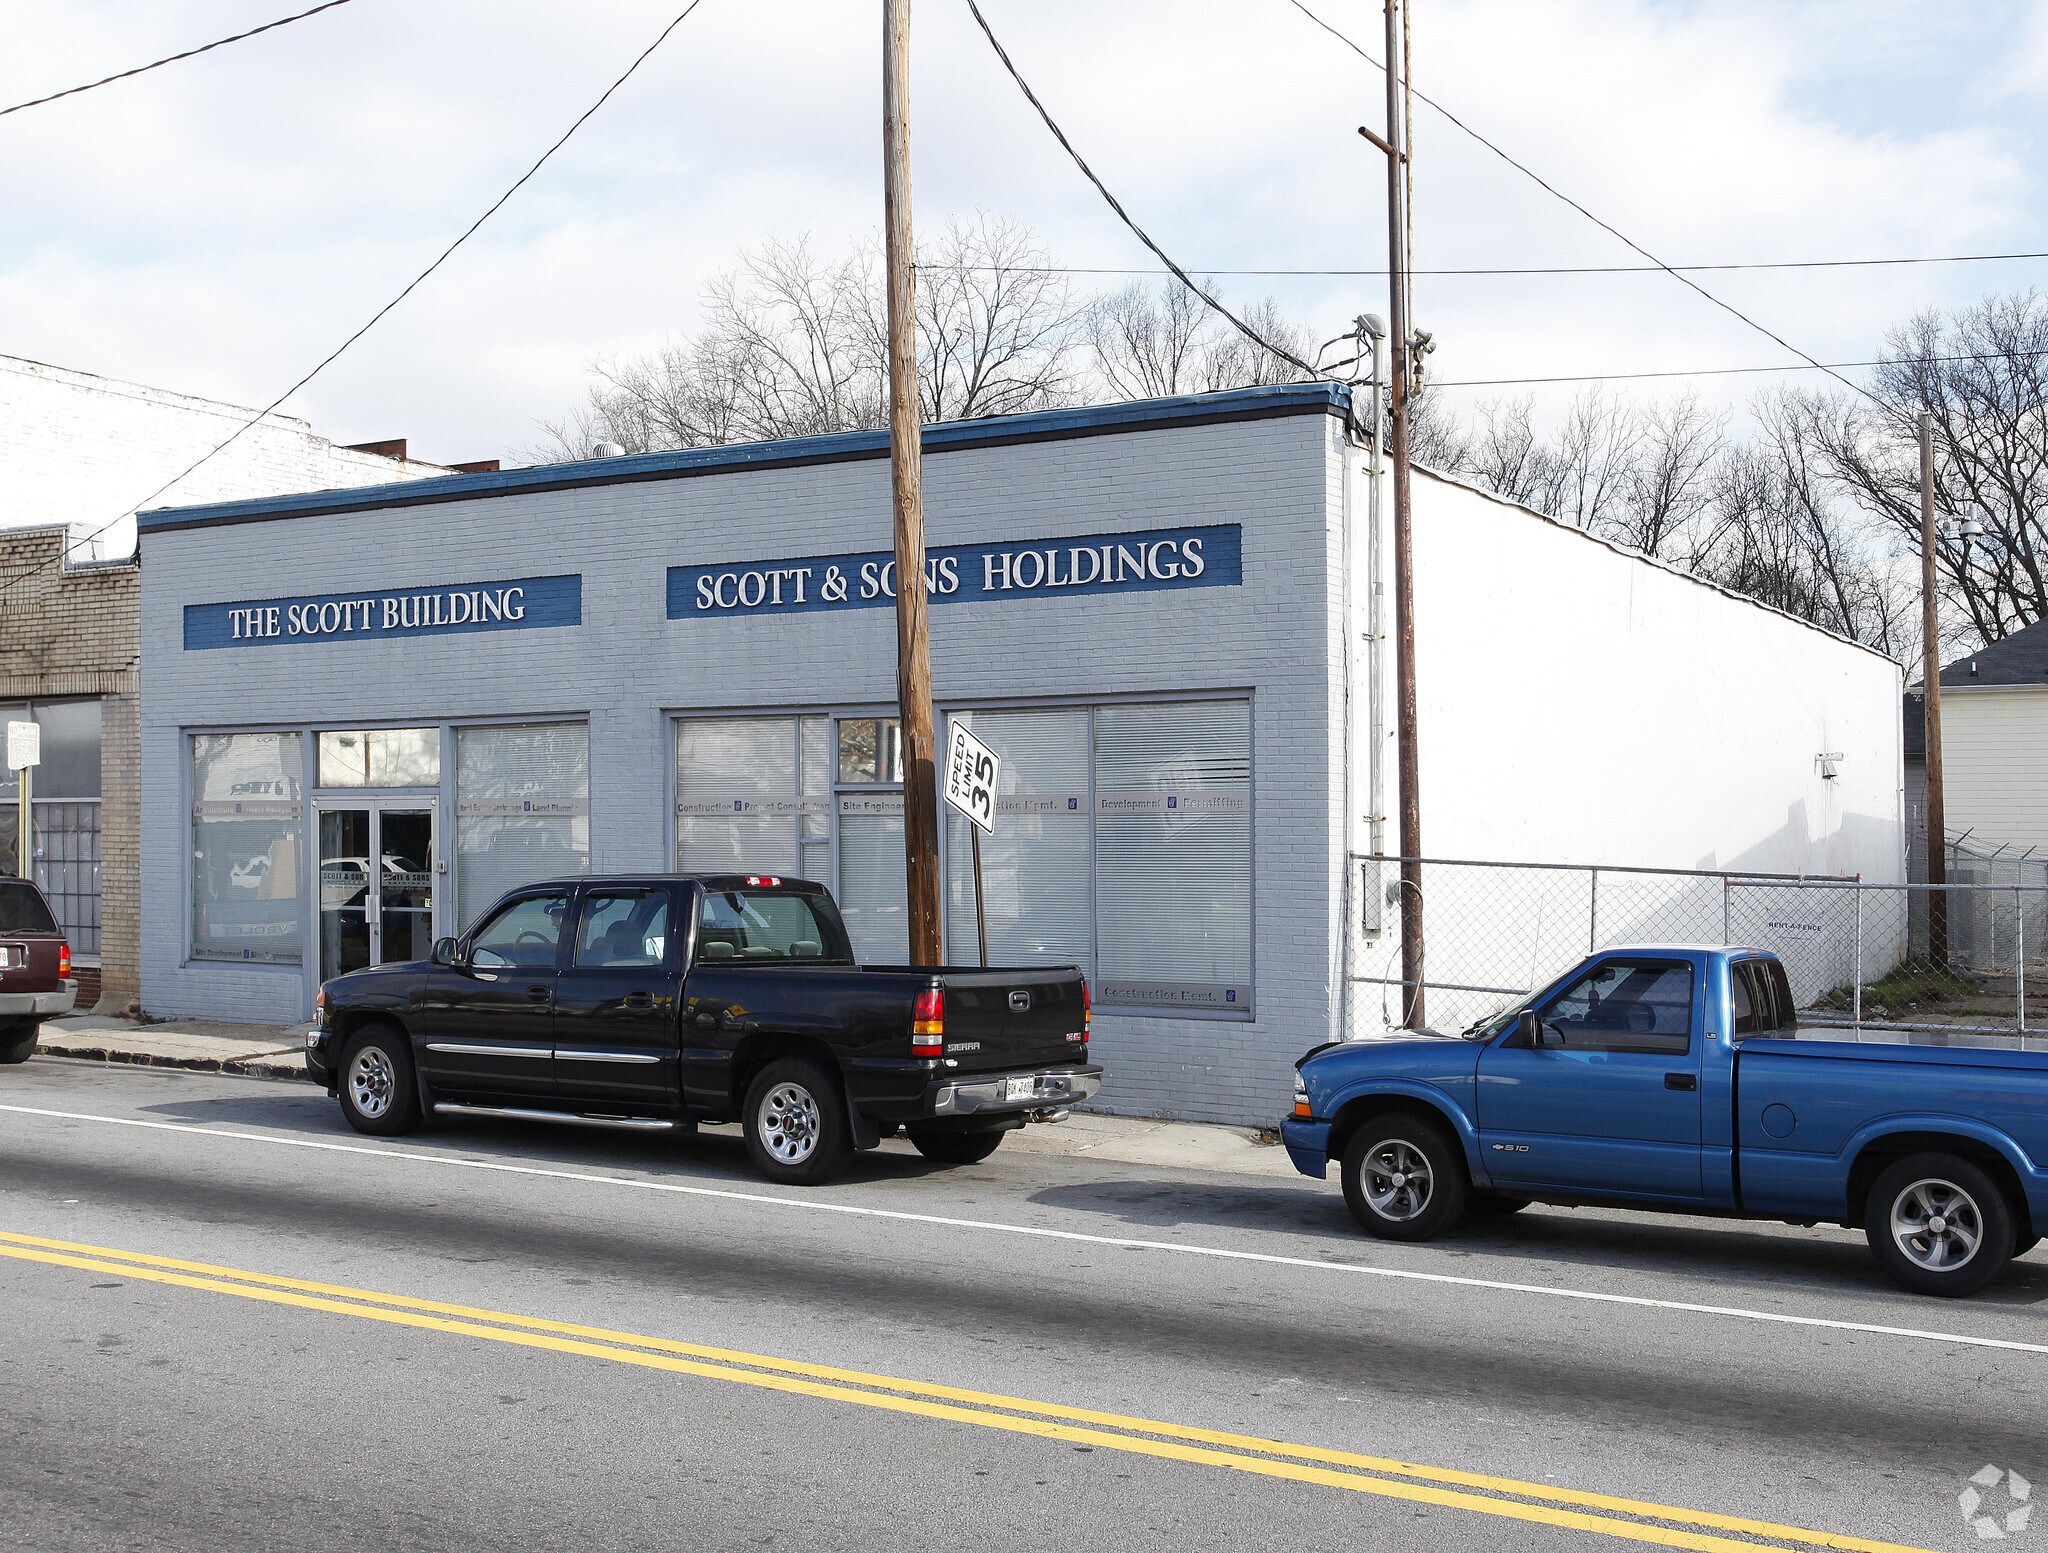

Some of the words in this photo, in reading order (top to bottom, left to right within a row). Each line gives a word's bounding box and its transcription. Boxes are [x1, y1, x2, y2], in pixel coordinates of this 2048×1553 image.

[695, 568, 813, 610] SCOTT
[820, 565, 849, 602] &
[982, 537, 1205, 592] HOLDINGS
[228, 608, 281, 639] THE
[288, 599, 375, 636] SCOTT
[381, 587, 526, 630] BUILDING
[951, 733, 966, 798] SPEED
[962, 748, 975, 799] LIMIT
[971, 751, 994, 820] 35
[532, 803, 550, 812] Land
[677, 802, 732, 813] Construction
[843, 801, 862, 811] Site
[864, 801, 905, 813] Engineer
[1101, 798, 1162, 811] Development
[1768, 921, 1822, 932] RENT-A-FENCE
[1104, 986, 1178, 1000] Construction
[947, 1041, 981, 1052] SIERRA
[1504, 1144, 1530, 1152] S10
